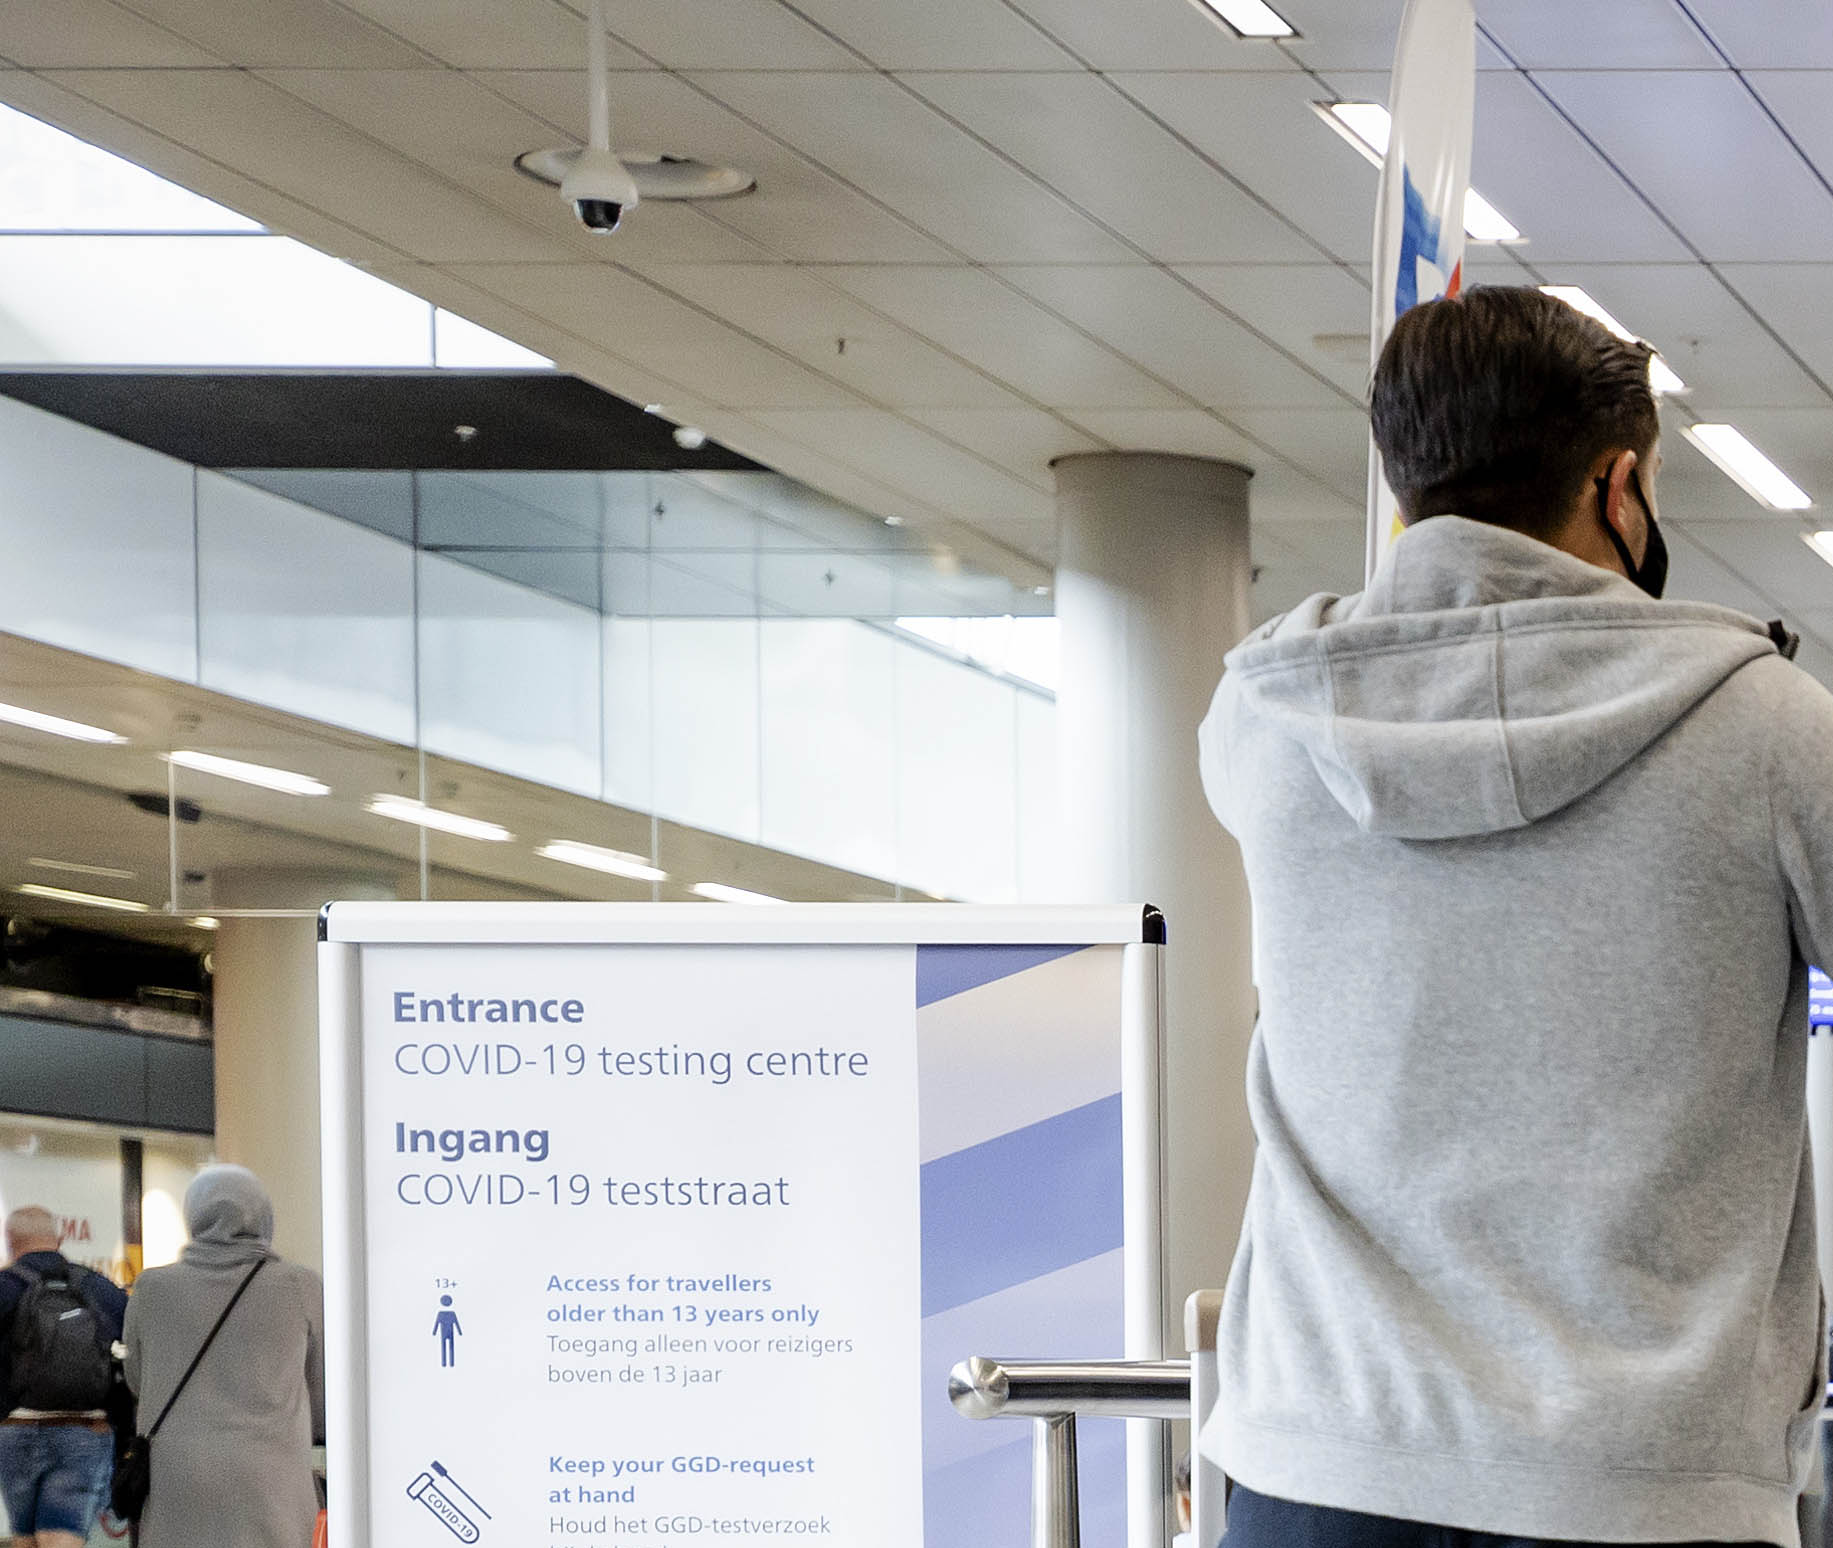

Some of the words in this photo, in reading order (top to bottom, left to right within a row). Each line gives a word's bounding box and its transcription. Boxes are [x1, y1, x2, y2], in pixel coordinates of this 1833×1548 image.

[394, 992, 584, 1023] Entrance
[395, 1044, 585, 1075] COVID-19
[598, 1044, 731, 1085] testing
[747, 1048, 868, 1076] centre
[396, 1122, 549, 1162] Ingang
[398, 1174, 590, 1205] COVID-19
[603, 1177, 789, 1205] teststraat
[435, 1278, 457, 1289] 13+
[547, 1275, 620, 1292] Access
[627, 1274, 660, 1292] for
[666, 1274, 771, 1292] travellers
[547, 1304, 605, 1322] older
[613, 1304, 664, 1322] than
[673, 1305, 697, 1322] 13
[705, 1309, 764, 1327] years
[771, 1304, 819, 1327] only
[547, 1335, 637, 1357] Toegang
[645, 1334, 707, 1352] alleen
[714, 1339, 760, 1352] voor
[768, 1336, 853, 1357] reizigers
[548, 1365, 612, 1383] boven
[619, 1364, 644, 1383] de
[653, 1365, 676, 1383] 13
[682, 1366, 722, 1387] jaar
[550, 1456, 605, 1477] Keep
[612, 1460, 664, 1477] your
[672, 1456, 814, 1477] GGD-request
[549, 1488, 571, 1503] at
[579, 1486, 634, 1503] hand
[427, 1493, 474, 1539] COVID-19
[550, 1516, 606, 1534] Houd
[614, 1516, 647, 1534] het
[655, 1515, 830, 1534] GGD-testverzoek
